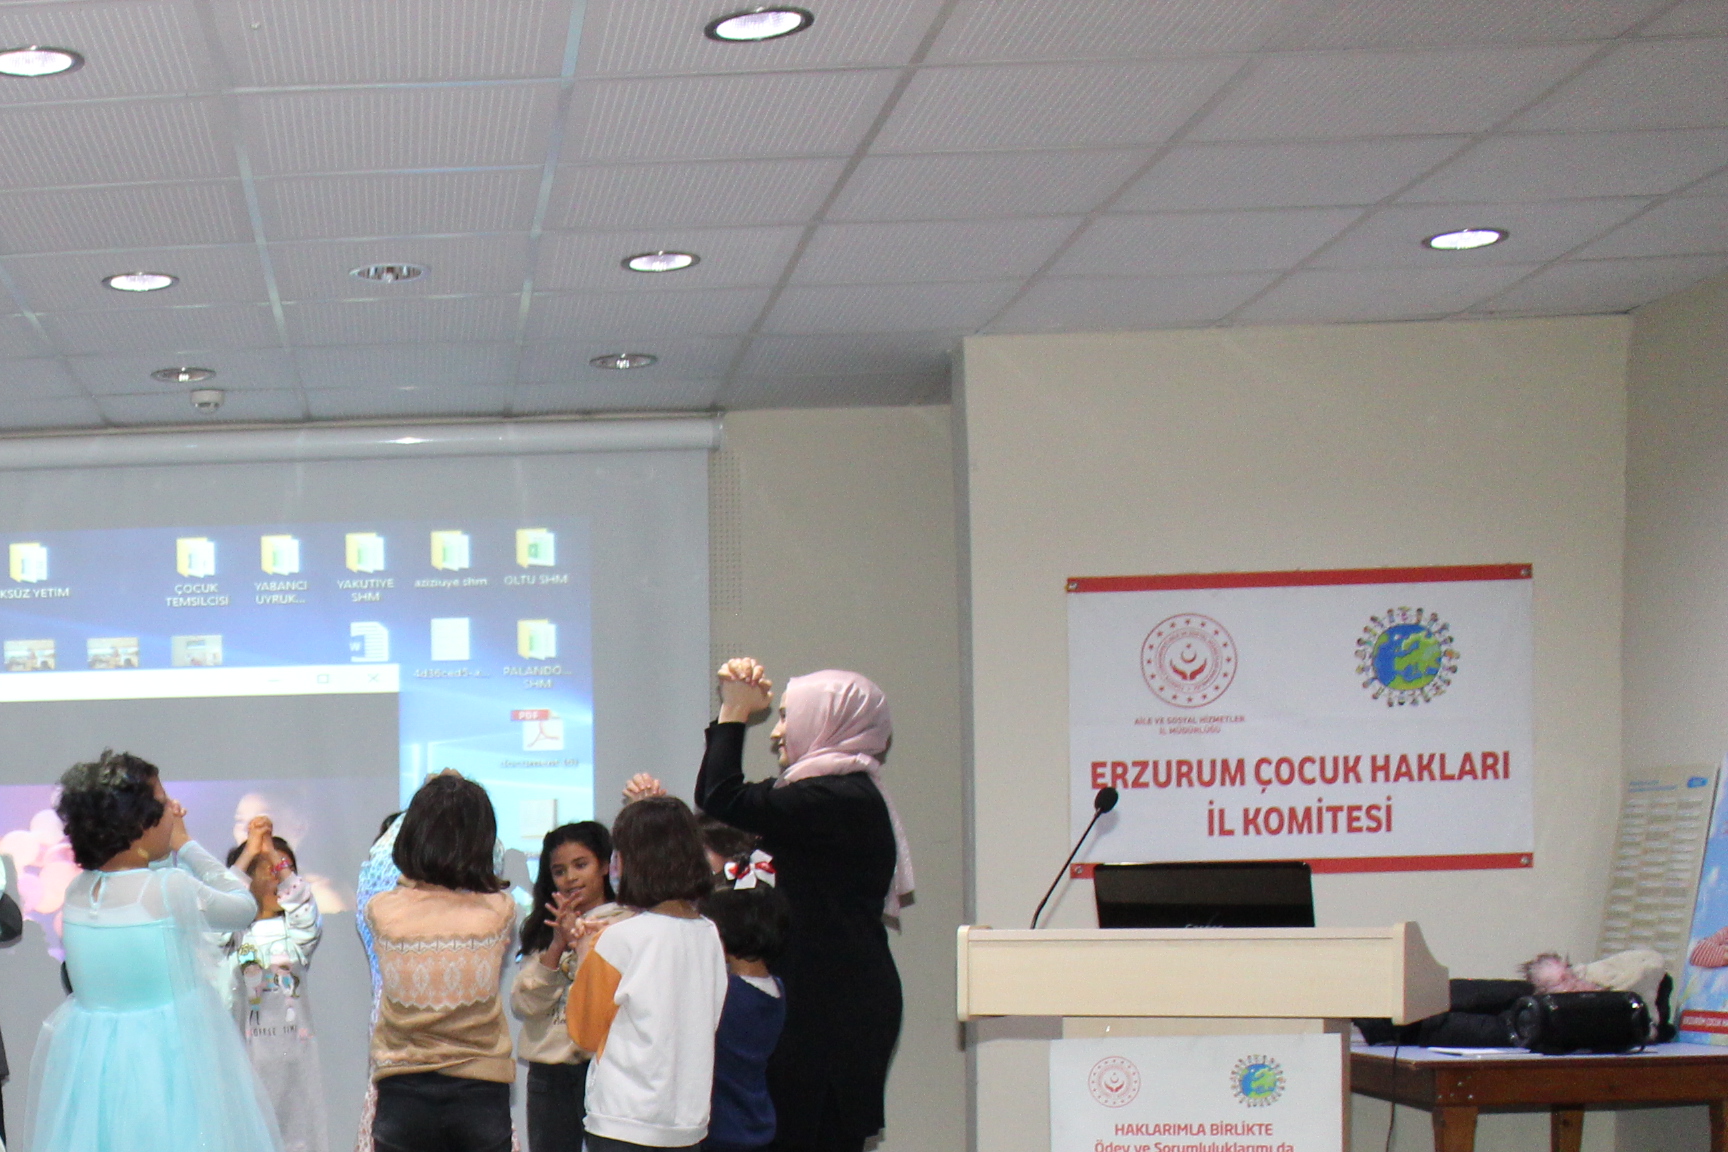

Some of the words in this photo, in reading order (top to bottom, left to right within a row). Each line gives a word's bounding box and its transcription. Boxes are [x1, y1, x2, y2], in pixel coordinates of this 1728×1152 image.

[503, 575, 535, 585] OLTU
[539, 574, 569, 585] SHM
[174, 583, 218, 595] ÇOCUK
[351, 592, 380, 602] SHM
[1091, 758, 1246, 790] ERZURUM
[1254, 755, 1362, 794] ÇOCUK
[1370, 750, 1511, 783] HAKLARI
[1207, 798, 1235, 836] İL
[1242, 794, 1393, 836] KOMİTESİ
[1115, 1123, 1206, 1136] HAKLARIMLA
[1210, 1120, 1273, 1136] BİRLİKTE
